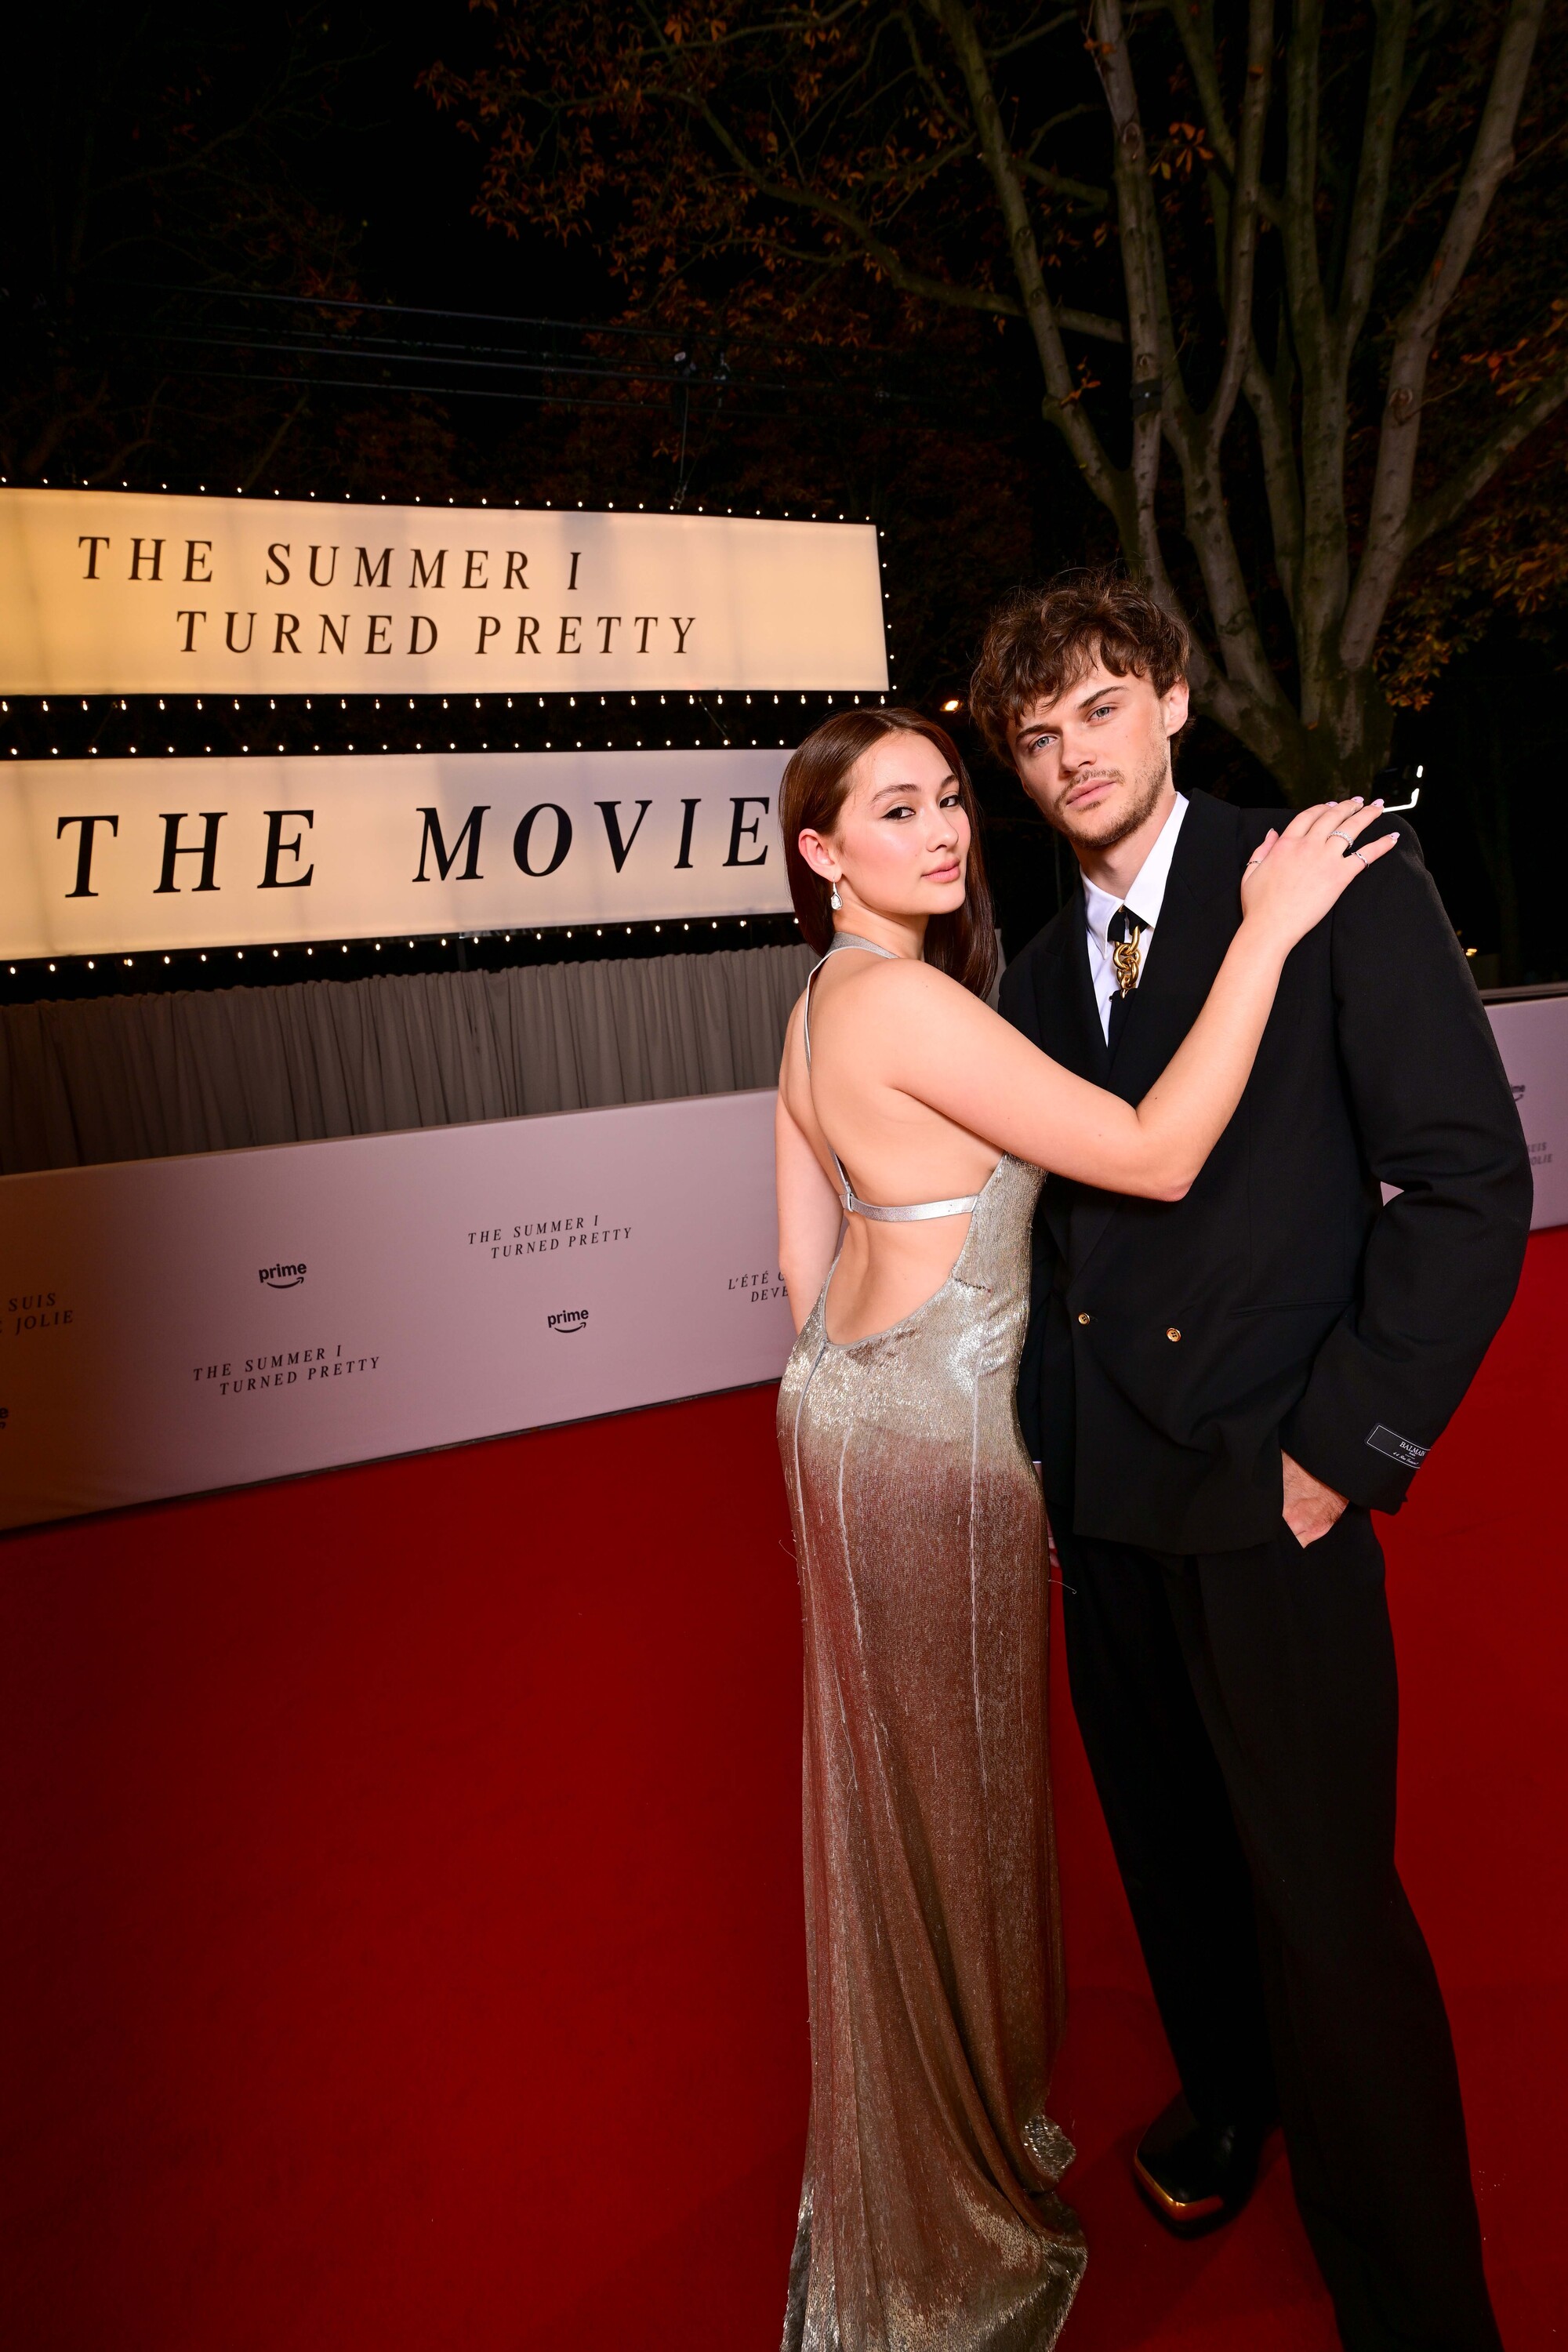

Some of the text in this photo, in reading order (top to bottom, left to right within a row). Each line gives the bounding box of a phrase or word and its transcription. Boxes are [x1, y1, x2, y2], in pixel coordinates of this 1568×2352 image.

[78, 535, 582, 590] THE SUMMER I
[176, 611, 695, 655] TURNED PRETTY
[56, 797, 770, 898] THE MOVIE
[1530, 1154, 1552, 1165] OLIE
[468, 1214, 599, 1245] THE SUMMER I
[491, 1227, 633, 1259] TURNED PRETTY
[258, 1263, 307, 1283] prime
[8, 1293, 56, 1312] SUIS
[751, 1286, 789, 1302] DEVE
[16, 1310, 73, 1336] JOLIE
[547, 1308, 590, 1328] prime
[193, 1345, 343, 1381] THE SUMMER I
[220, 1356, 381, 1396] TURNED PRETTY
